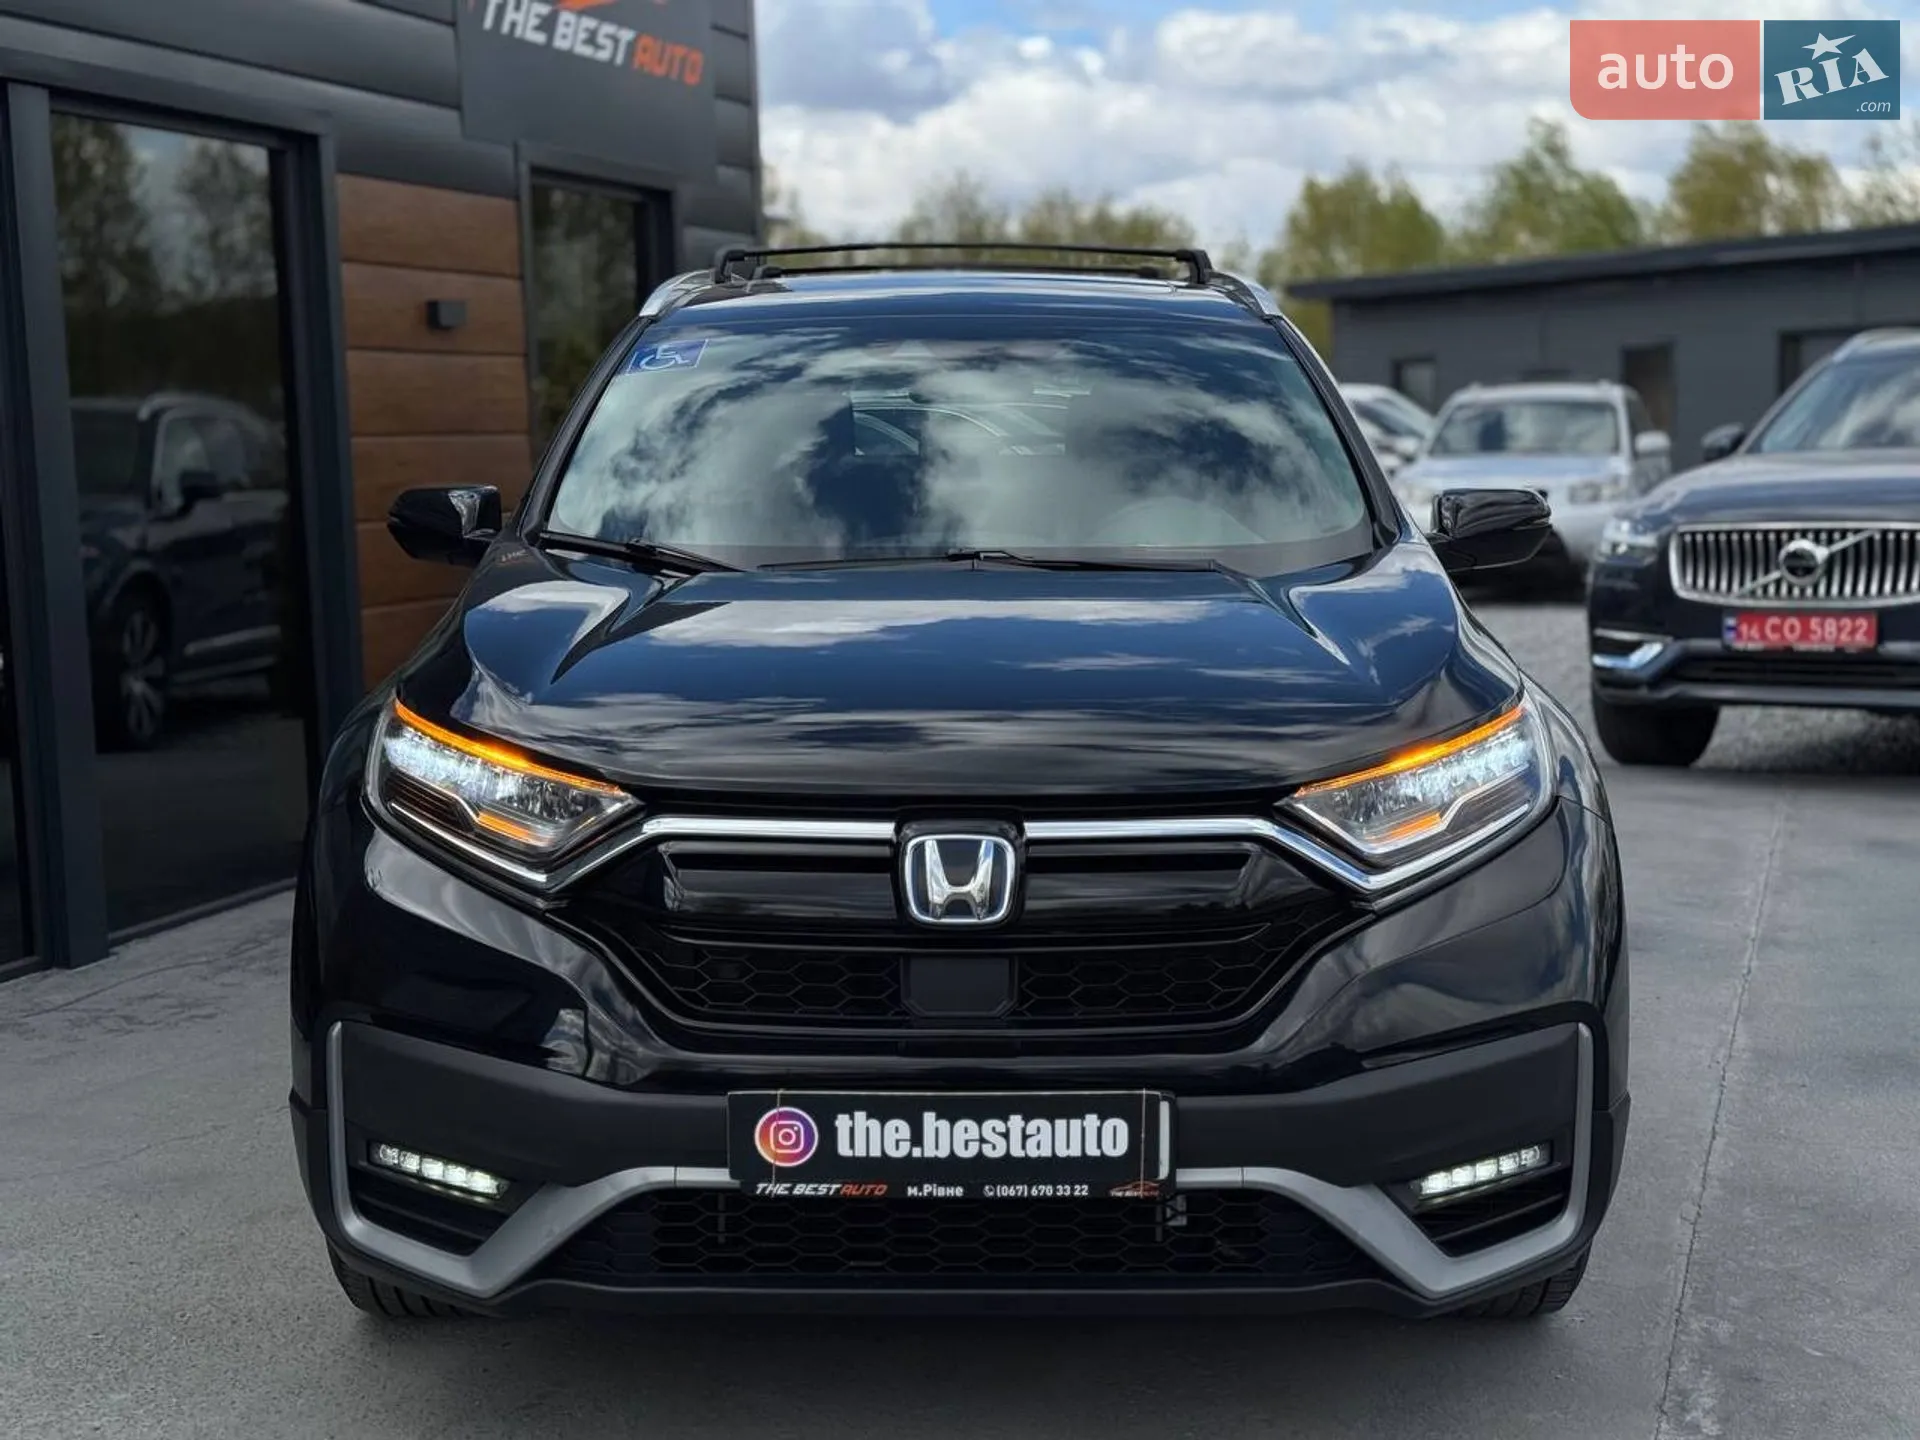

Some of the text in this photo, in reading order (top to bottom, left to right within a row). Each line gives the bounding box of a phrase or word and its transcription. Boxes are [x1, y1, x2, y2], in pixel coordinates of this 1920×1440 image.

[483, 0, 703, 85] THE BEST AUTO
[1764, 615, 1801, 640] CO
[1809, 615, 1869, 640] 5822
[835, 1111, 1129, 1158] the.bestauto
[756, 1183, 888, 1196] THE BEST AUTO
[996, 1184, 1089, 1197] (067) 670 33 22
